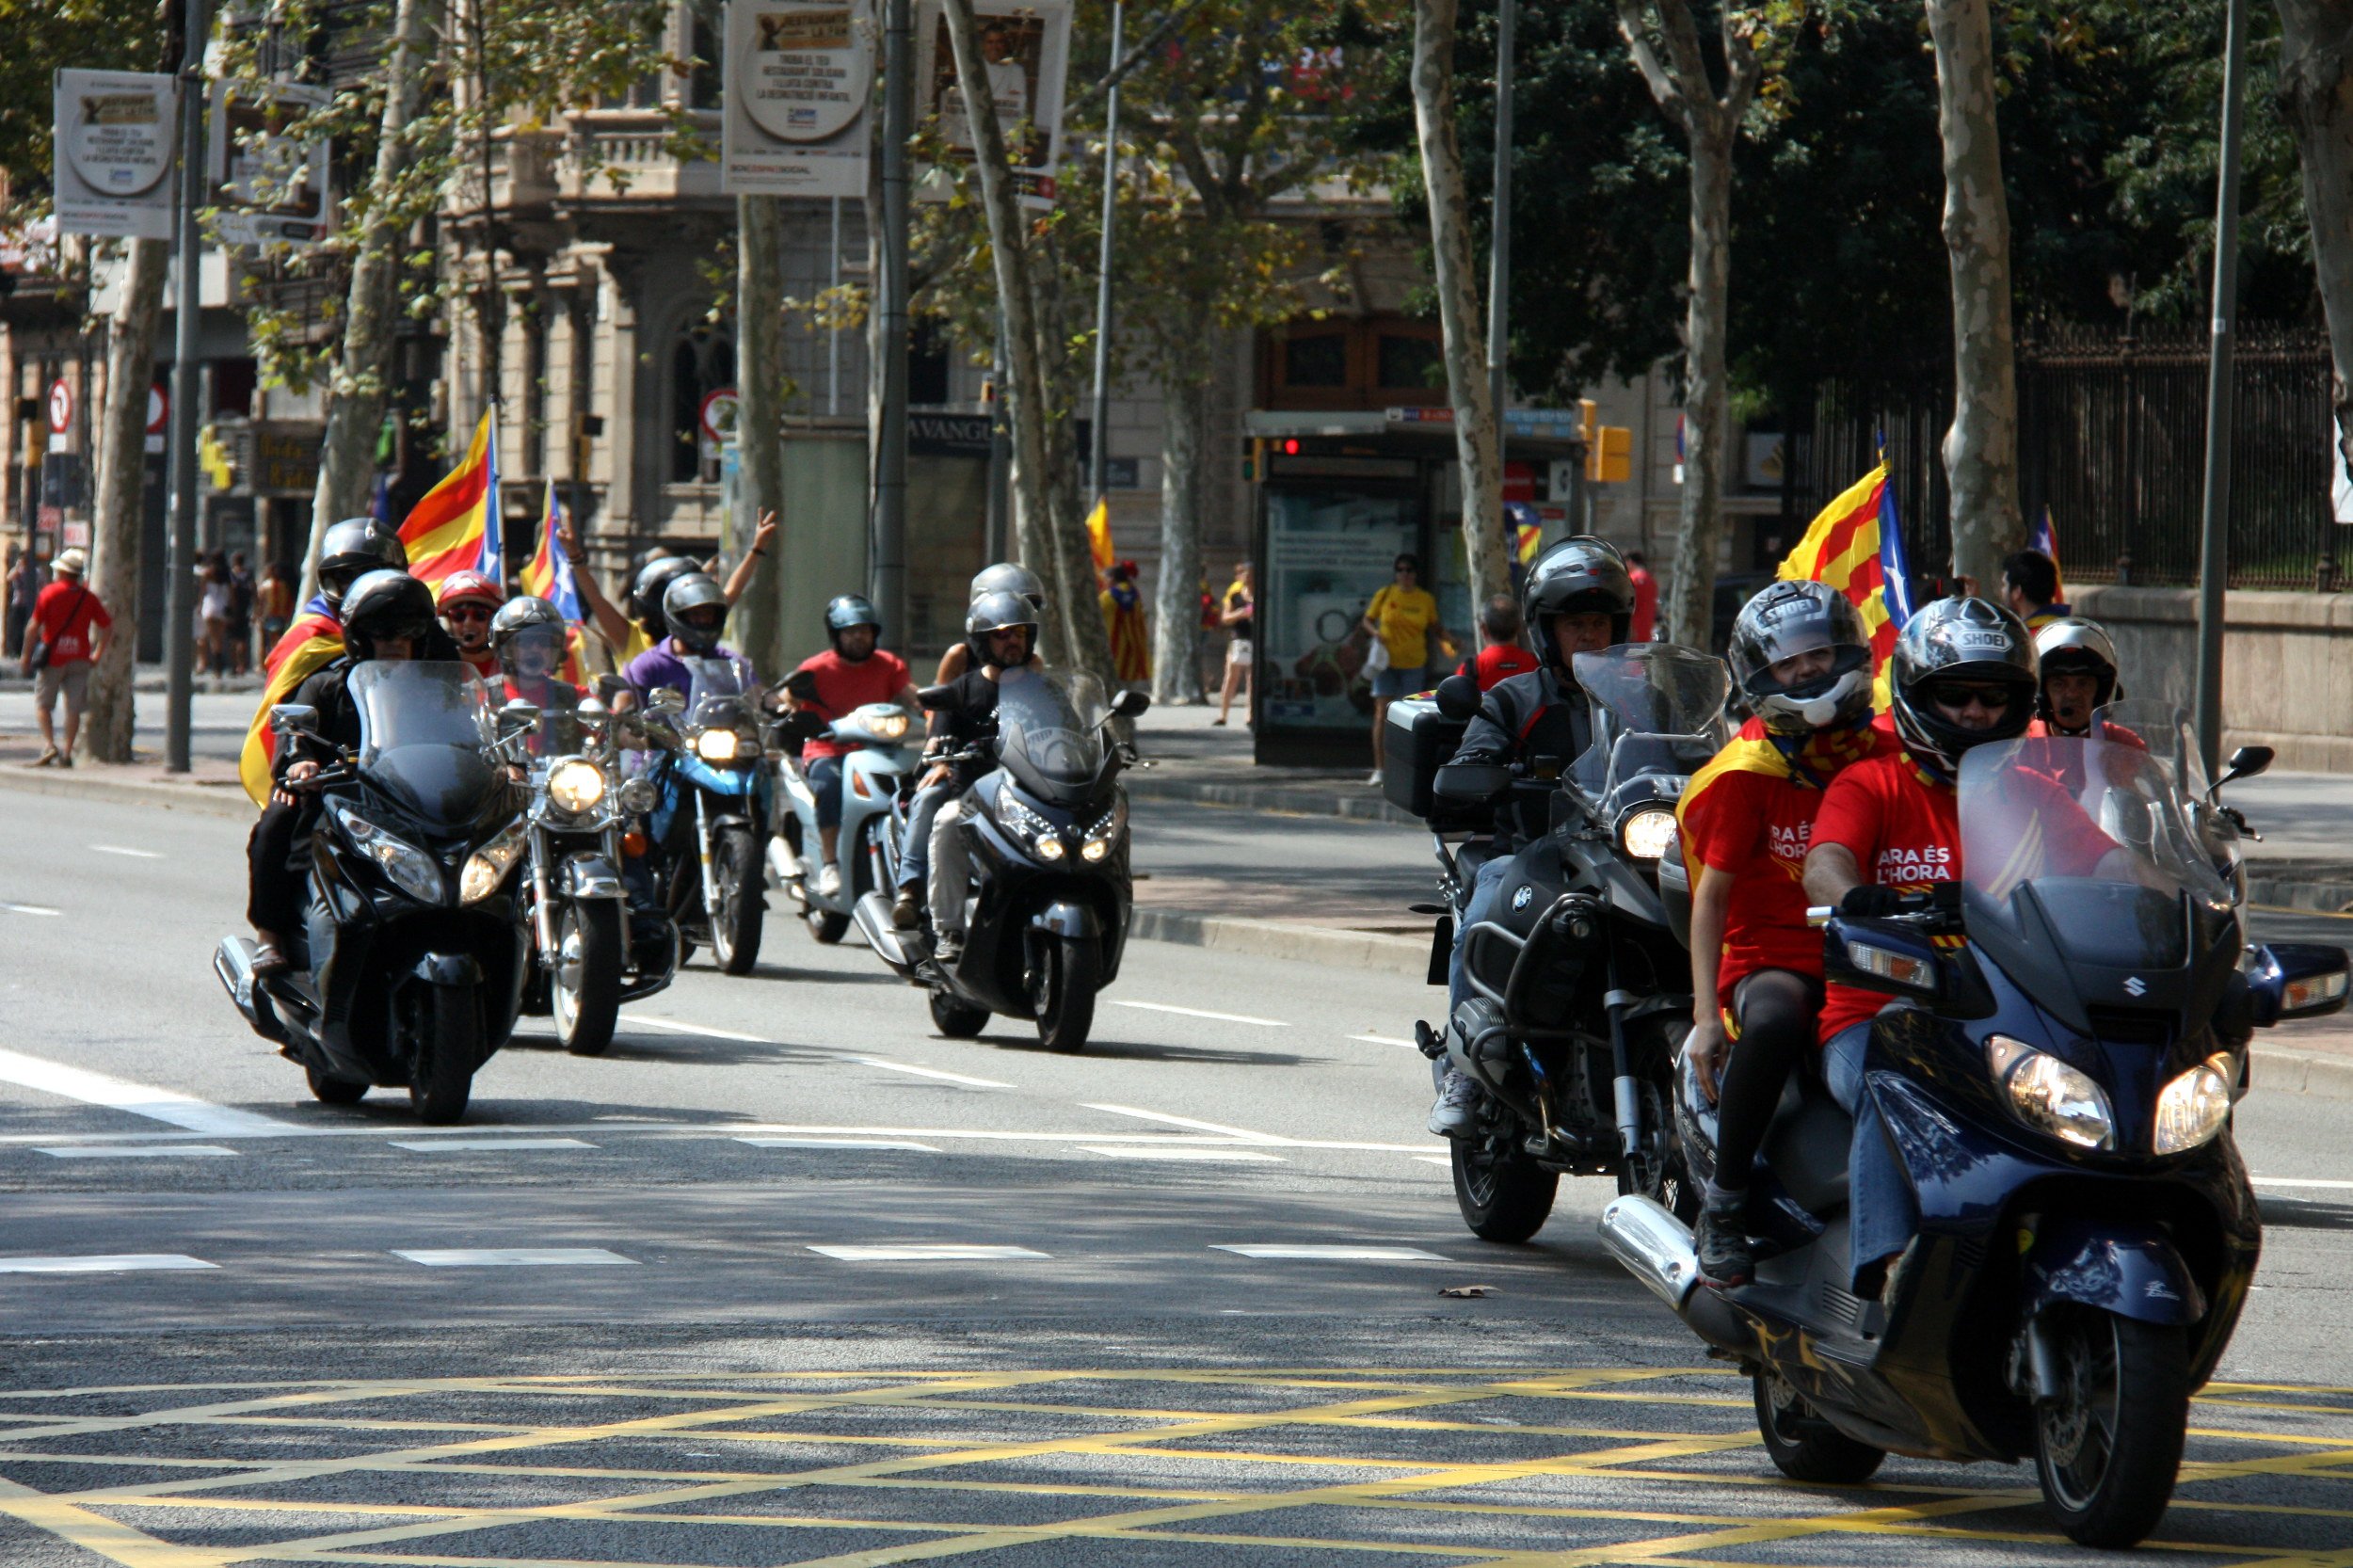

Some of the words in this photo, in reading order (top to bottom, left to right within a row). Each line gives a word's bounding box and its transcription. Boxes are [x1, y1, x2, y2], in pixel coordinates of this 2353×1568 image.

[1766, 599, 1813, 622] SHOEI
[1962, 632, 2005, 648] SHOEI
[1770, 824, 1796, 841] RA
[1769, 840, 1808, 858] LHOR
[1878, 848, 1921, 866] ARA
[1925, 844, 1951, 864] ÉS
[1876, 864, 1951, 885] L'HORA
